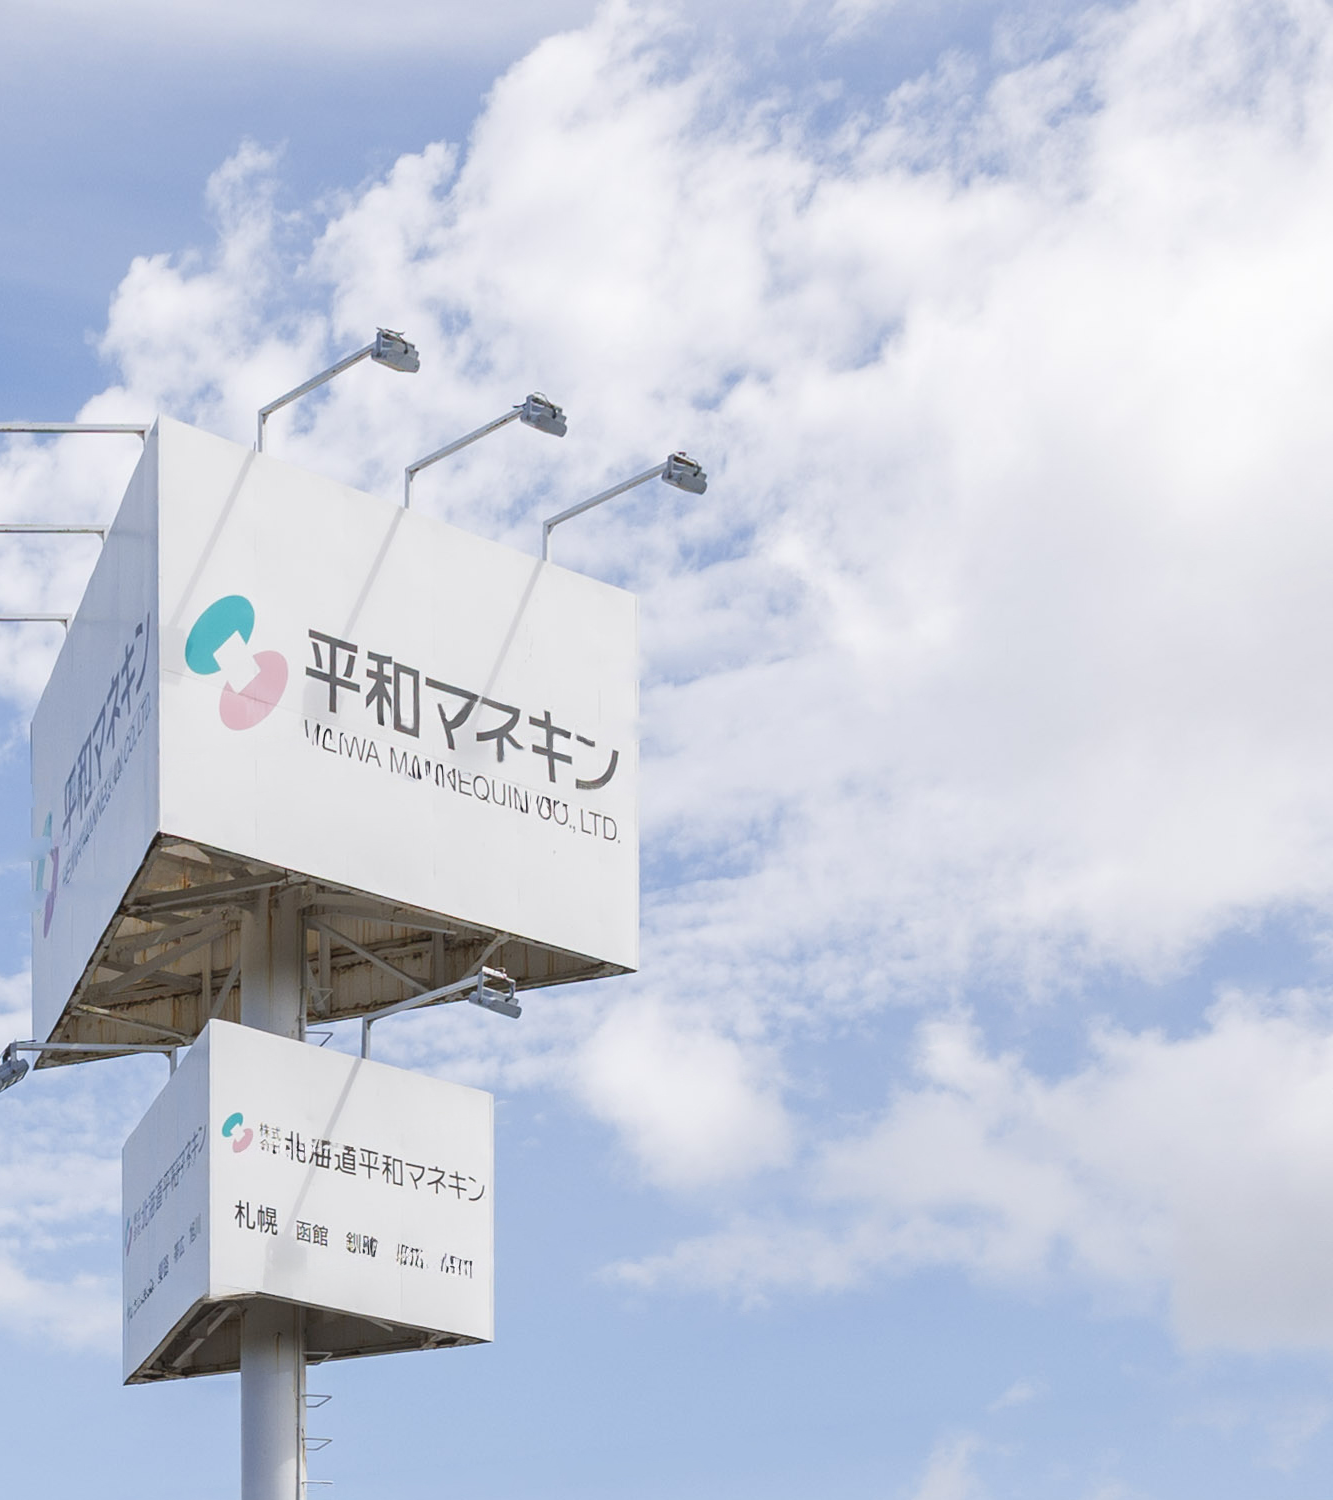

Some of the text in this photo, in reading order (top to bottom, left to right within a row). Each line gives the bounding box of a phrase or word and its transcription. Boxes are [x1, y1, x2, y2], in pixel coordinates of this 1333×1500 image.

[306, 628, 619, 790] 平和マネキン
[580, 808, 621, 844] LTD.
[284, 1130, 486, 1201] 北海道平和マネキン
[234, 1199, 279, 1236] 札幌
[295, 1220, 329, 1247] 函館
